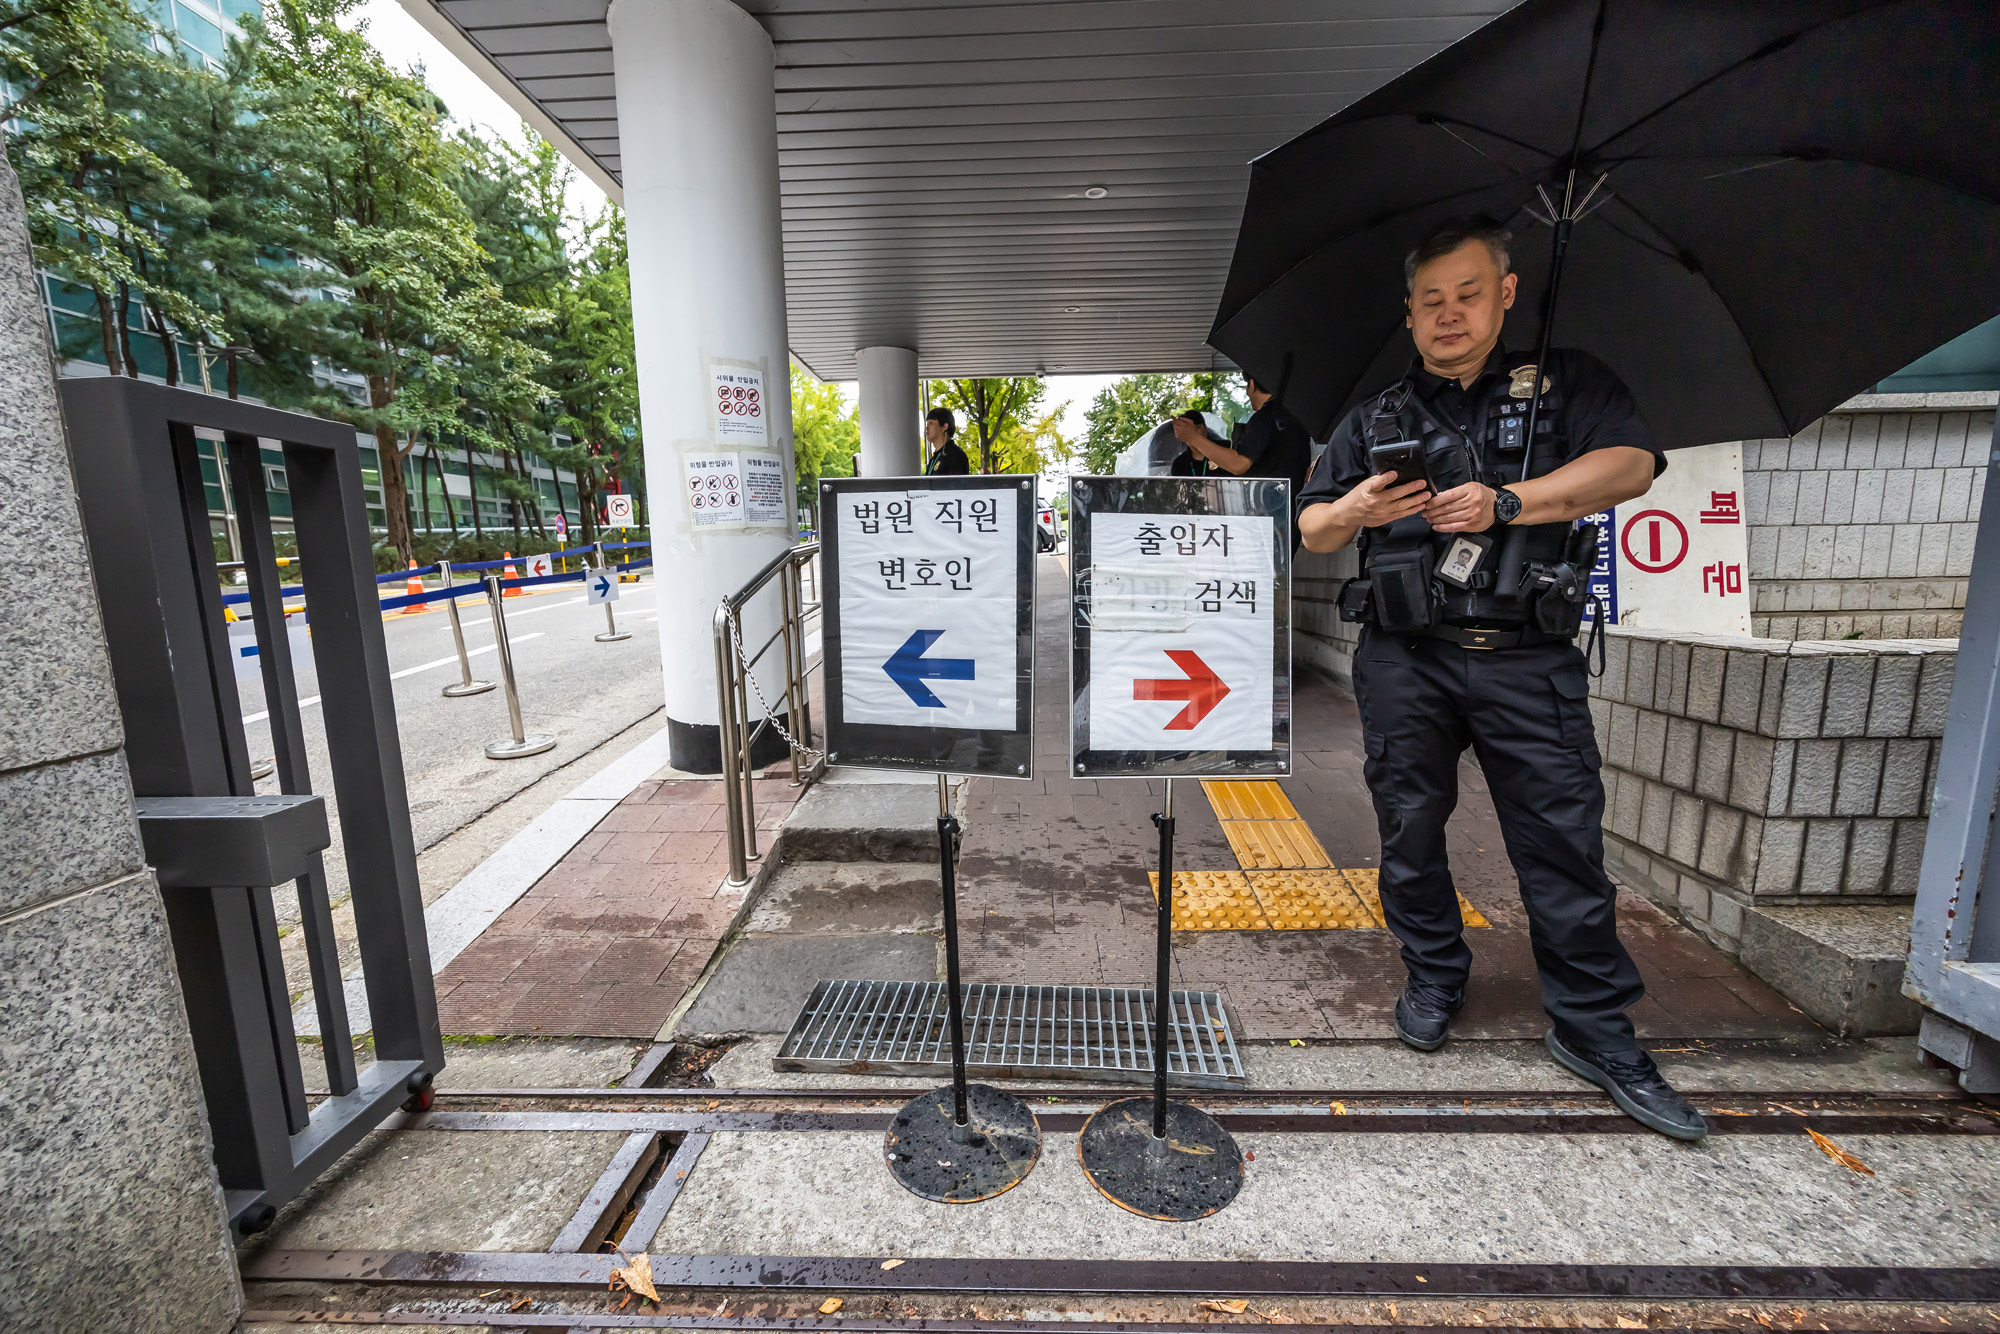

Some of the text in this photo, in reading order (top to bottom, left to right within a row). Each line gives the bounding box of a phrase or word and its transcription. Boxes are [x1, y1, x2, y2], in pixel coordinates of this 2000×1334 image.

[716, 374, 759, 385] 시위물 반입금지
[689, 459, 733, 468] 위험물 반입금지
[853, 498, 999, 534] 법원 직원
[1134, 522, 1234, 557] 출입자
[1700, 491, 1742, 597] 폐 문
[878, 556, 973, 591] 변호인
[1195, 579, 1256, 614] 검색
